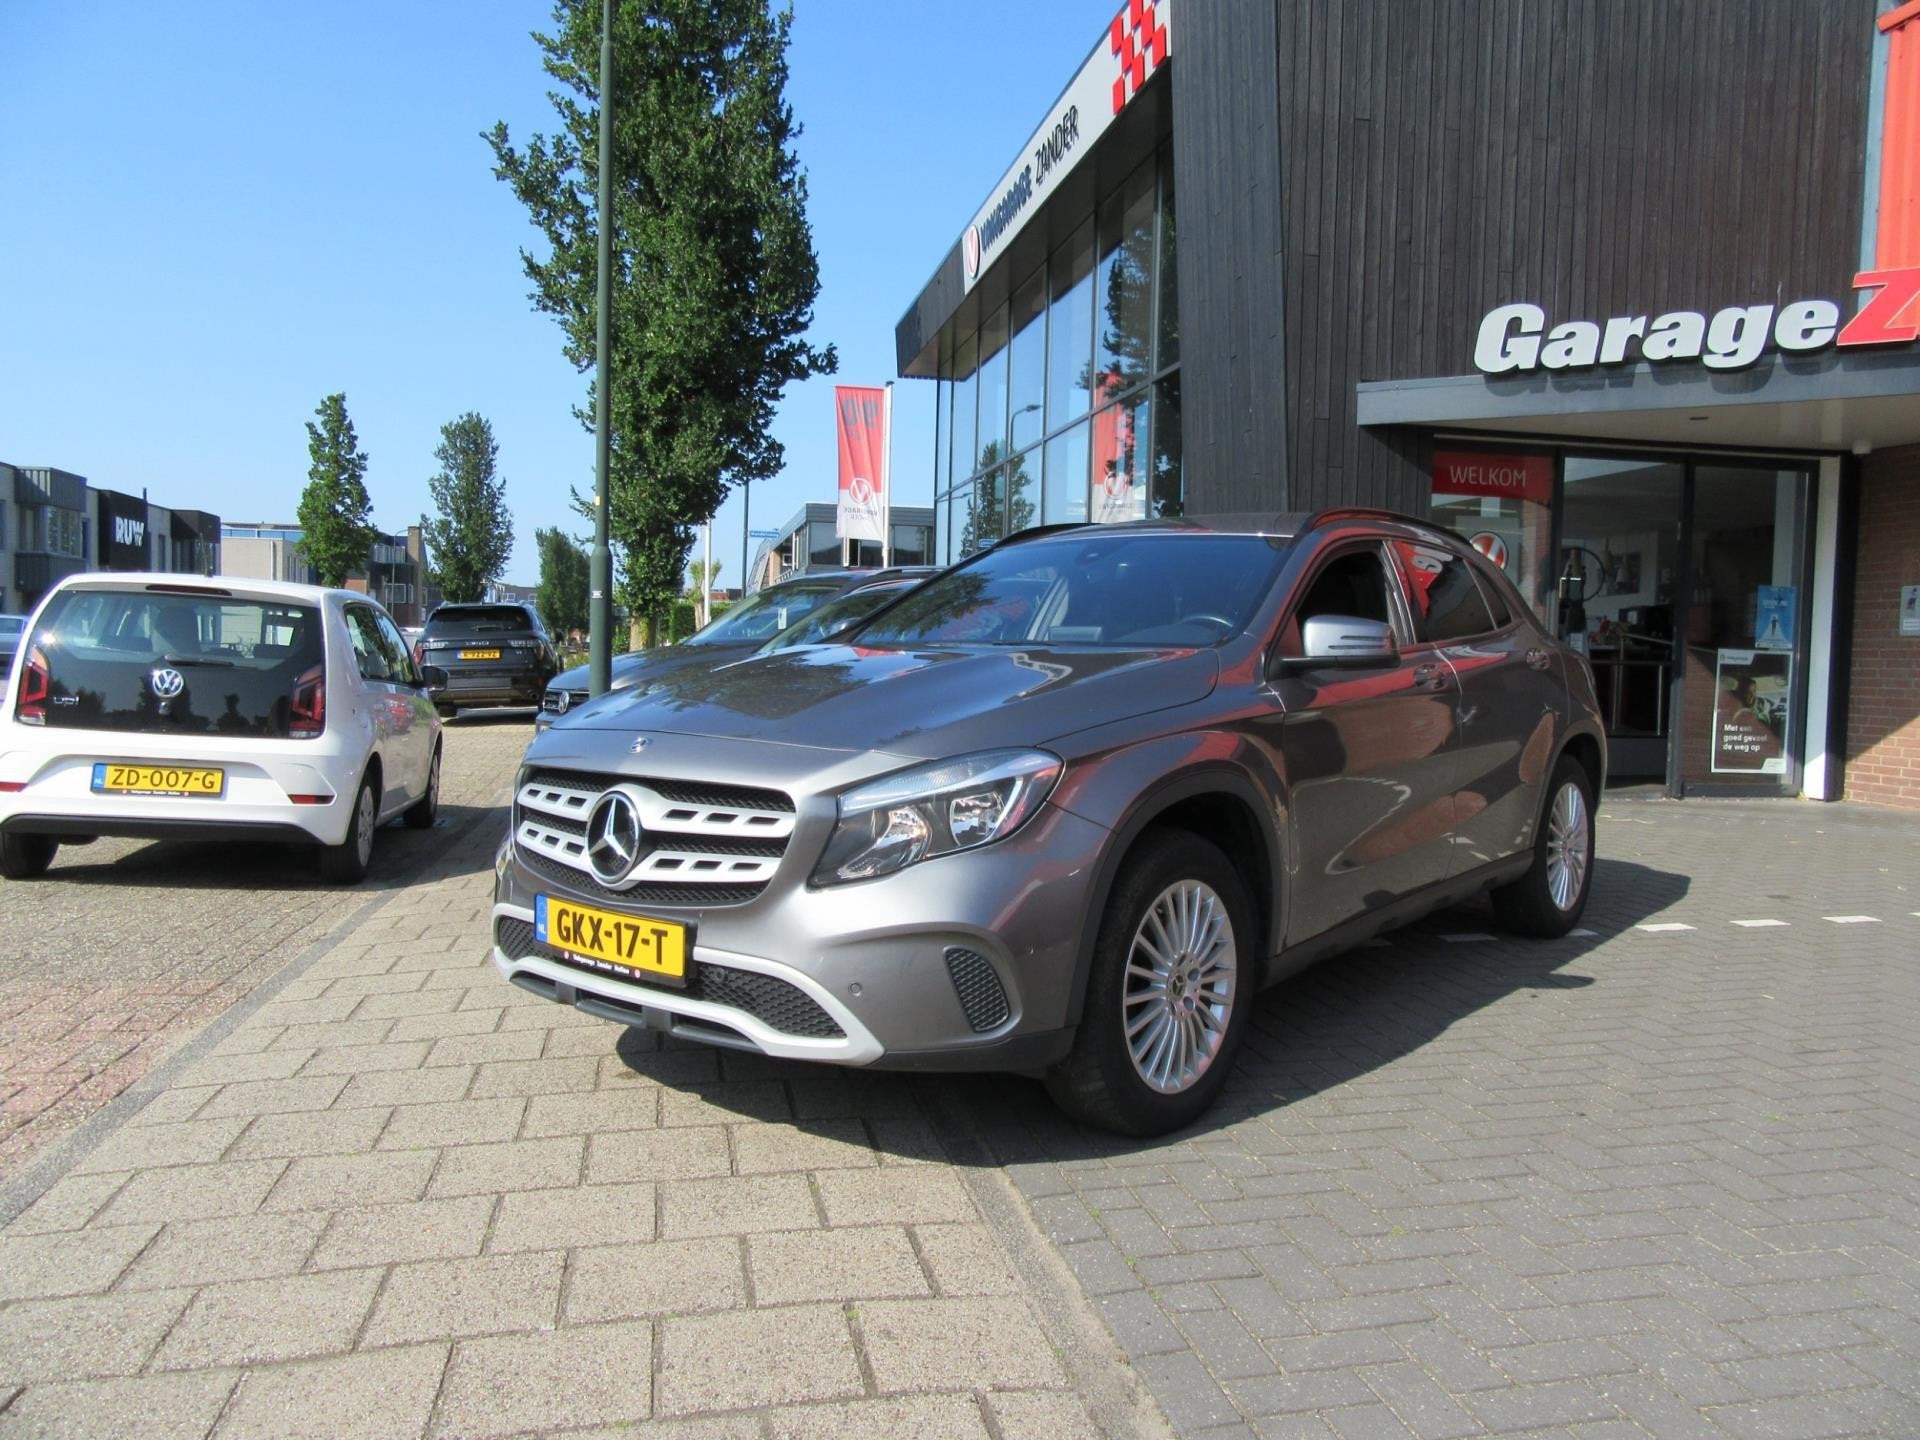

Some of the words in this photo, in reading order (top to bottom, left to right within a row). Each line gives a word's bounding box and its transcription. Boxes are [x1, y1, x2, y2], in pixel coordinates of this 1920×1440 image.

[1034, 104, 1079, 187] ZANDER
[1473, 299, 1840, 374] Garage
[1449, 465, 1527, 487] WELKOM
[1723, 734, 1742, 743] goed
[1743, 734, 1768, 743] gevoel
[1724, 724, 1739, 732] Met
[1722, 743, 1733, 751] de
[1734, 744, 1750, 753] weg
[1750, 744, 1761, 752] op
[111, 768, 216, 790] ZD-007-G
[557, 908, 669, 966] GKX-17-T
